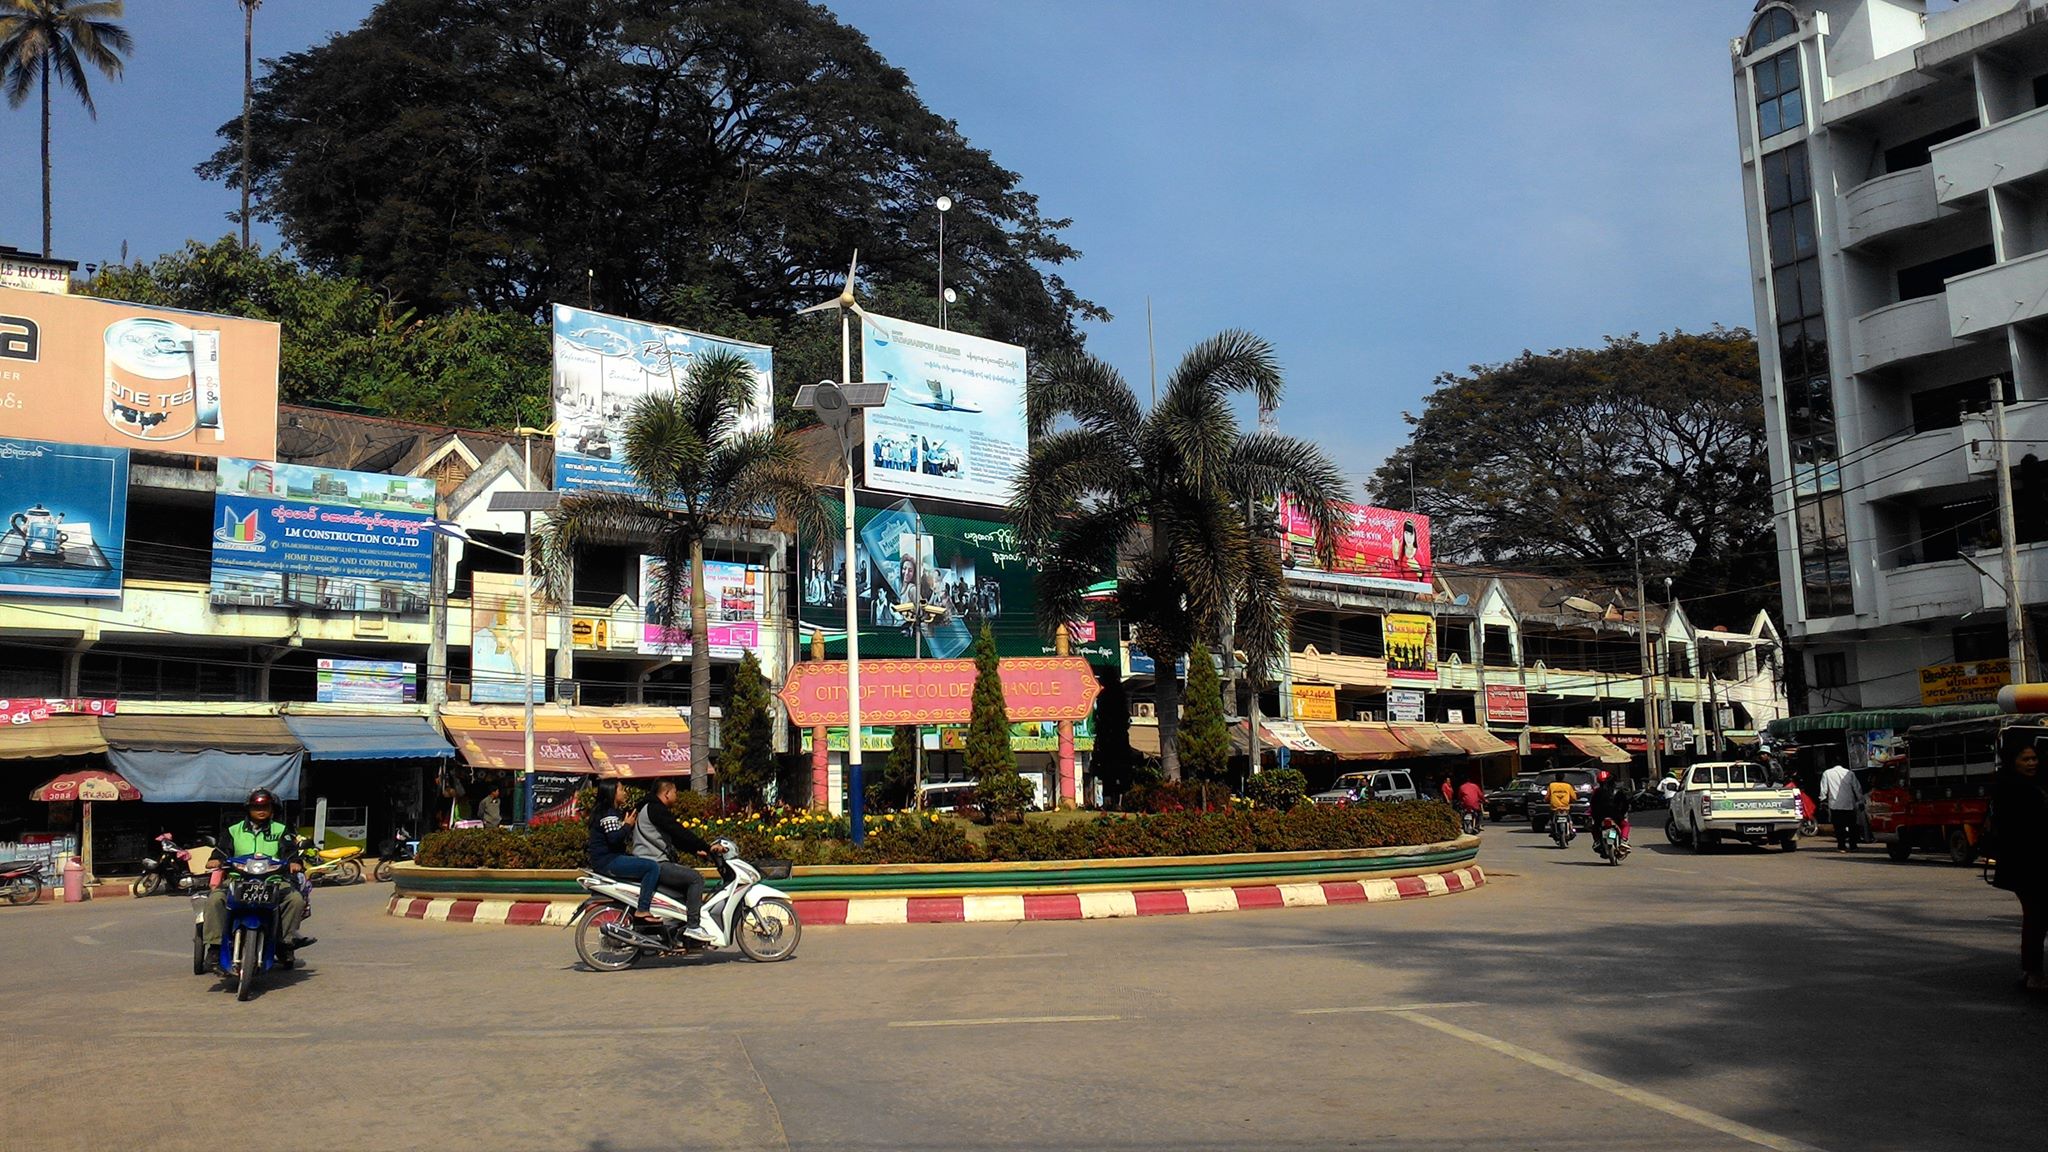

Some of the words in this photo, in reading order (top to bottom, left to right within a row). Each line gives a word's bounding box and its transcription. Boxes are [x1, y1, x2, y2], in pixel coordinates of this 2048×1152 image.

[18, 266, 66, 281] HOTEL
[284, 527, 300, 538] LM
[302, 529, 381, 544] CONSTRUCTION
[284, 552, 308, 562] HOME
[309, 554, 338, 564] DESIGN
[340, 556, 358, 565] AND
[359, 558, 418, 570] CONSTRUCTION
[816, 686, 849, 700] CITY
[883, 684, 912, 698] THE
[917, 682, 974, 698] GOLDE
[540, 744, 572, 754] GLAN
[540, 751, 581, 760] MASTER
